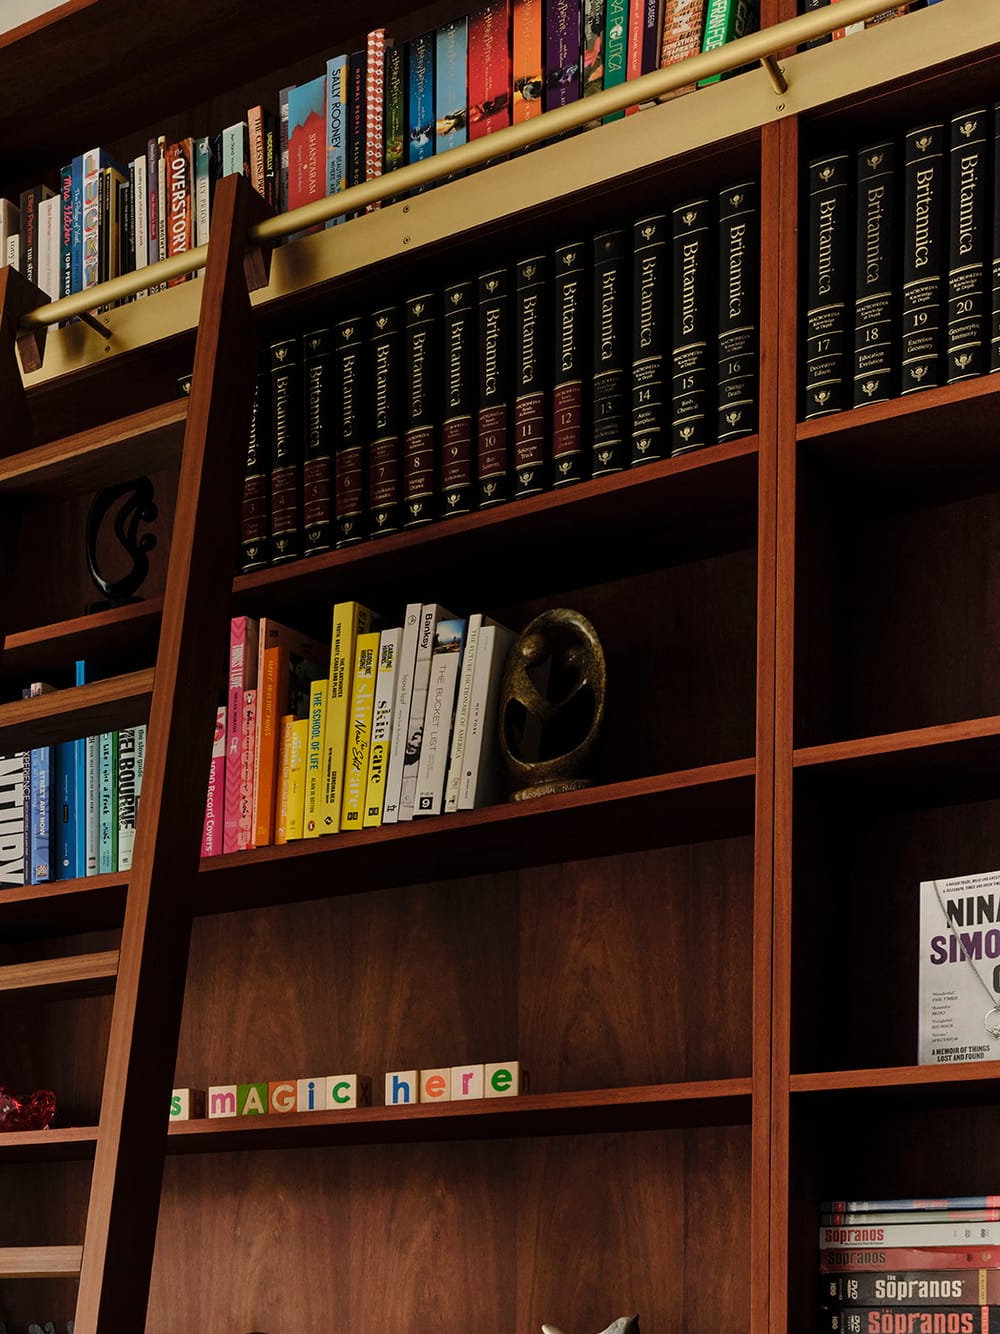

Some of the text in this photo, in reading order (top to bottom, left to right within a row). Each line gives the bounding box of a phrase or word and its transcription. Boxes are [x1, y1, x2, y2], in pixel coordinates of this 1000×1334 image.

[331, 68, 341, 149] SALLY ROONEY
[254, 118, 264, 177] THE CELESTINE
[266, 131, 274, 170] UNDERBELLY
[308, 133, 317, 194] SHANTARAM
[171, 158, 187, 254] OVERSTORY
[914, 167, 934, 269] Britannica
[958, 153, 978, 255] Britannica
[26, 215, 34, 247] Perlman
[818, 198, 836, 296] Britannica
[866, 184, 885, 285] Britannica
[681, 241, 699, 335] Britannica
[728, 223, 747, 318] Britannica
[600, 269, 617, 360] Britannica
[640, 255, 657, 348] Britannica
[913, 312, 928, 327] 19
[956, 299, 973, 314] 20
[521, 295, 537, 384] Britannica
[560, 282, 577, 372] Britannica
[817, 338, 830, 352] 17
[865, 327, 879, 341] 18
[449, 320, 465, 408] Britannica
[484, 308, 500, 397] Britannica
[728, 362, 741, 373] 16
[376, 344, 390, 429] Britannica
[411, 332, 426, 418] Britannica
[682, 378, 694, 390] 15
[310, 365, 323, 448] Britannica
[342, 355, 356, 438] Britannica
[639, 391, 651, 403] 14
[275, 376, 289, 458] Britannica
[522, 426, 532, 437] 11
[560, 414, 572, 425] 12
[450, 447, 459, 457] 9
[484, 435, 496, 448] 10
[412, 457, 422, 468] 8
[420, 613, 433, 649] Banksy
[364, 648, 373, 675] CAROLINE
[385, 643, 394, 669] CAROLINE
[436, 664, 448, 684] THE
[466, 645, 475, 670] FUTURE
[399, 673, 409, 705] loose leaf
[461, 672, 472, 712] DICTIONARY
[432, 687, 443, 729] BUCKET
[460, 713, 468, 728] OF
[309, 691, 322, 770] THE SCHOOL OF LIFE
[370, 699, 391, 784] skin care
[428, 731, 438, 752] LIST
[454, 728, 465, 760] AMERICA
[471, 719, 479, 736] YORK
[136, 729, 145, 778] the slow guide
[38, 770, 46, 799] STREET
[204, 784, 216, 852] Record Covers
[936, 1047, 959, 1055] MEMOIR
[392, 1068, 513, 1104] here
[825, 1228, 884, 1244] Sopranos
[827, 1251, 886, 1266] Sopranos
[875, 1279, 962, 1301] Sopranos
